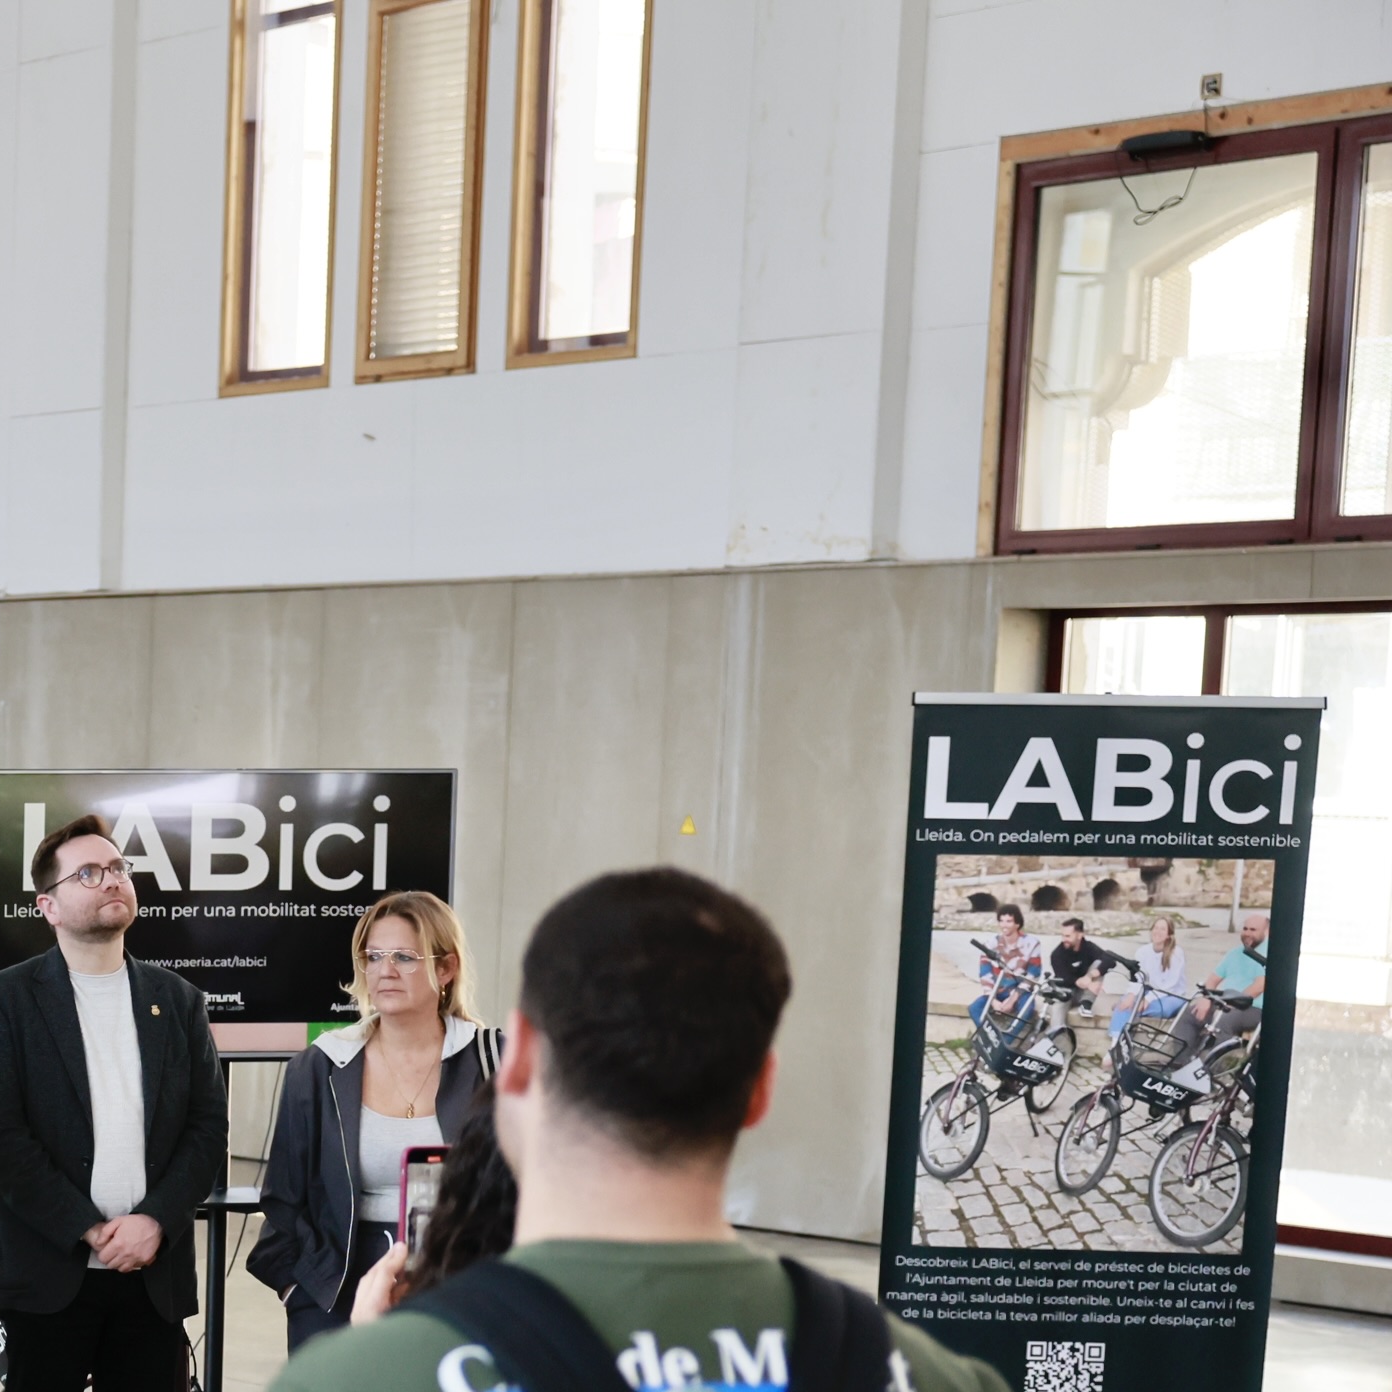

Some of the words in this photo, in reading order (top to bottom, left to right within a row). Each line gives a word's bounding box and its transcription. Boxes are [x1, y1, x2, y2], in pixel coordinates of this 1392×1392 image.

[924, 731, 1302, 825] LABici
[916, 828, 966, 842] Lleida.
[969, 829, 995, 843] On
[998, 829, 1070, 846] pedalem
[1073, 833, 1101, 846] per
[1104, 833, 1136, 845] una
[1140, 832, 1214, 847] mobilitat
[1217, 834, 1301, 848] sostenible
[4, 903, 44, 918] Lleid
[171, 904, 199, 920] per
[204, 905, 236, 917] una
[240, 903, 317, 918] mobilitat
[321, 903, 374, 917] soste
[895, 1255, 968, 1267] Descobreix
[971, 1257, 1016, 1270] LABici,
[1019, 1259, 1031, 1270] el
[1033, 1259, 1072, 1270] servei
[1074, 1260, 1092, 1272] de
[1095, 1260, 1144, 1273] préstec
[1147, 1261, 1165, 1273] de
[1168, 1262, 1231, 1276] bicicletes
[1233, 1264, 1251, 1276] de
[905, 1272, 992, 1287] l'Ajuntament
[994, 1275, 1012, 1287] de
[1015, 1276, 1054, 1288] Lleida
[1057, 1279, 1079, 1290] per
[1082, 1278, 1134, 1290] moure't
[1138, 1281, 1161, 1292] per
[1164, 1279, 1175, 1291] la
[1178, 1280, 1217, 1293] ciutat
[1220, 1281, 1238, 1293] de
[886, 1291, 937, 1302] manera
[970, 1292, 1034, 1305] saludable
[1116, 1295, 1172, 1308] Uneix-te
[1175, 1297, 1187, 1309] al
[1190, 1297, 1226, 1310] canvi
[1236, 1298, 1255, 1311] fes
[901, 1306, 919, 1318] de
[923, 1307, 934, 1319] la
[937, 1307, 992, 1320] bicicleta
[995, 1308, 1007, 1320] la
[1010, 1310, 1038, 1321] teva
[1041, 1310, 1078, 1322] millor
[1081, 1311, 1121, 1324] aliada
[1124, 1314, 1147, 1325] per
